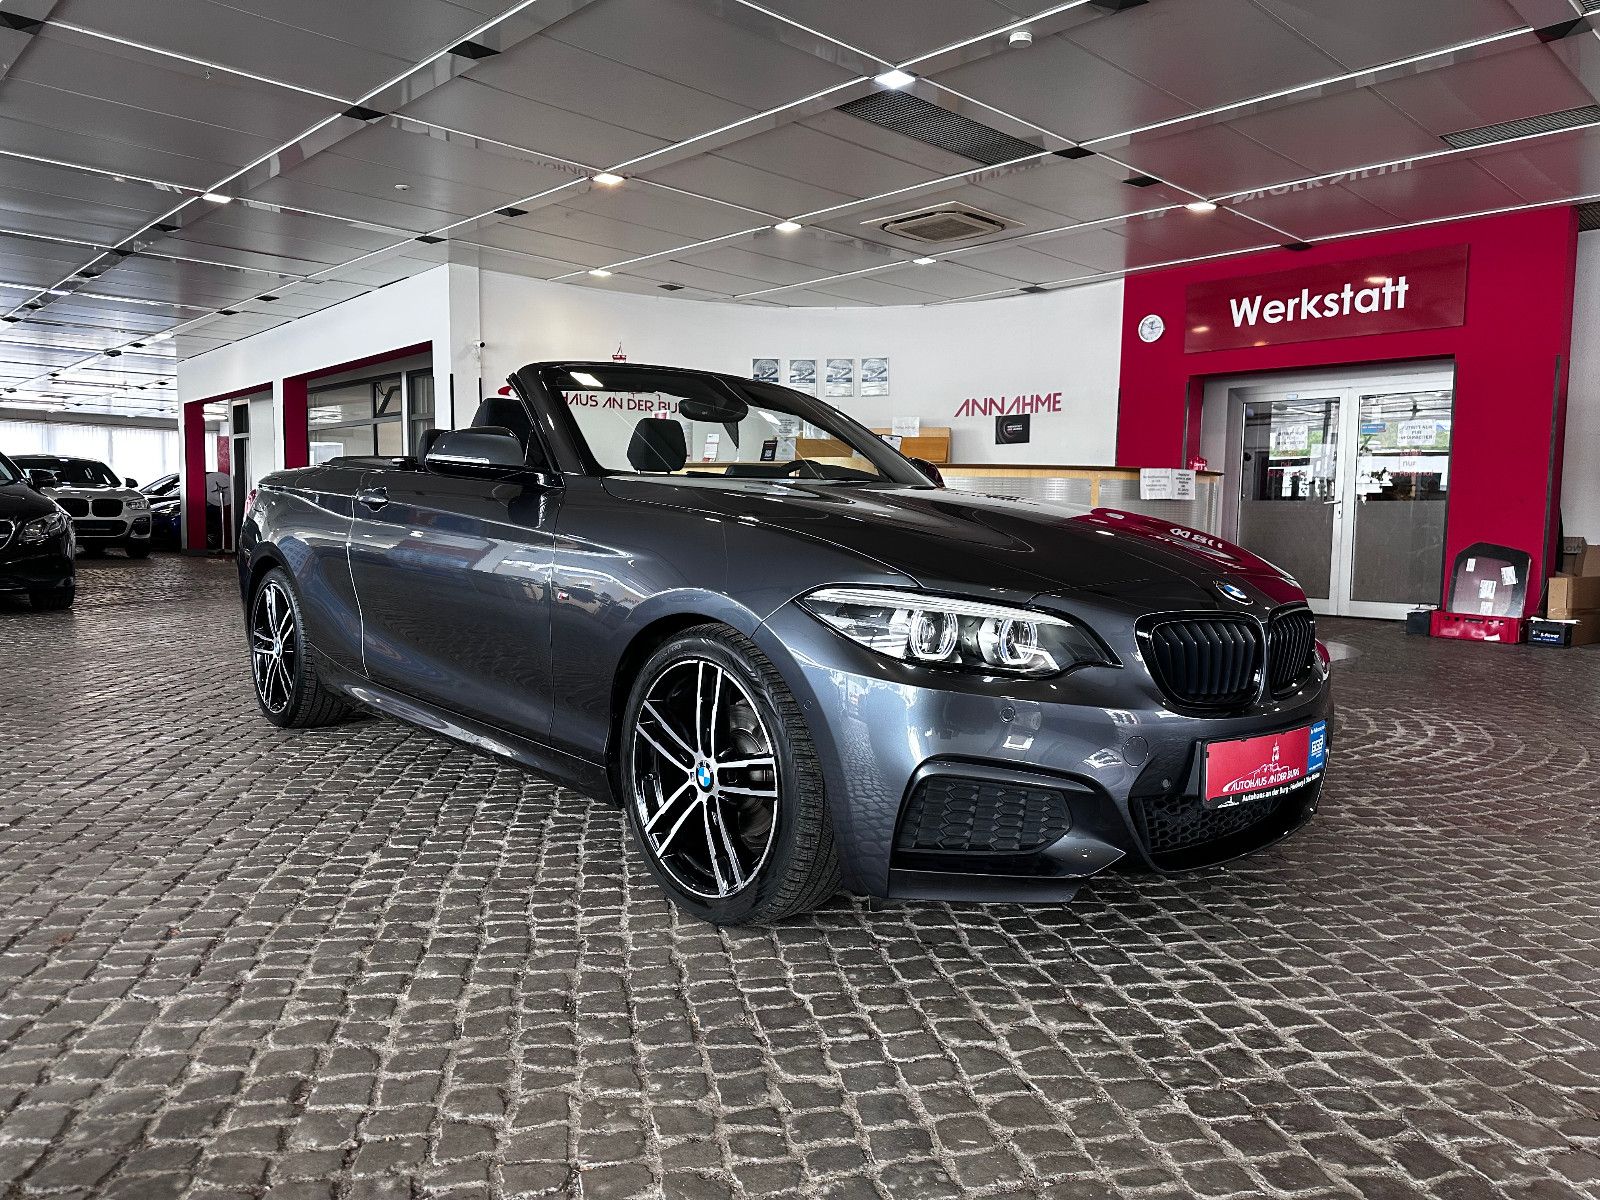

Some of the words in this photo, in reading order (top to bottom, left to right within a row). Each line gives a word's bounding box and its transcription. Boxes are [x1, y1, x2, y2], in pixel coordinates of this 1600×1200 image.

[1229, 276, 1409, 328] Werkstatt
[602, 397, 623, 410] AN
[627, 398, 654, 412] DER
[658, 401, 681, 414] BU
[954, 392, 1062, 417] ANNAHME
[1230, 776, 1267, 791] AUTOHAUS
